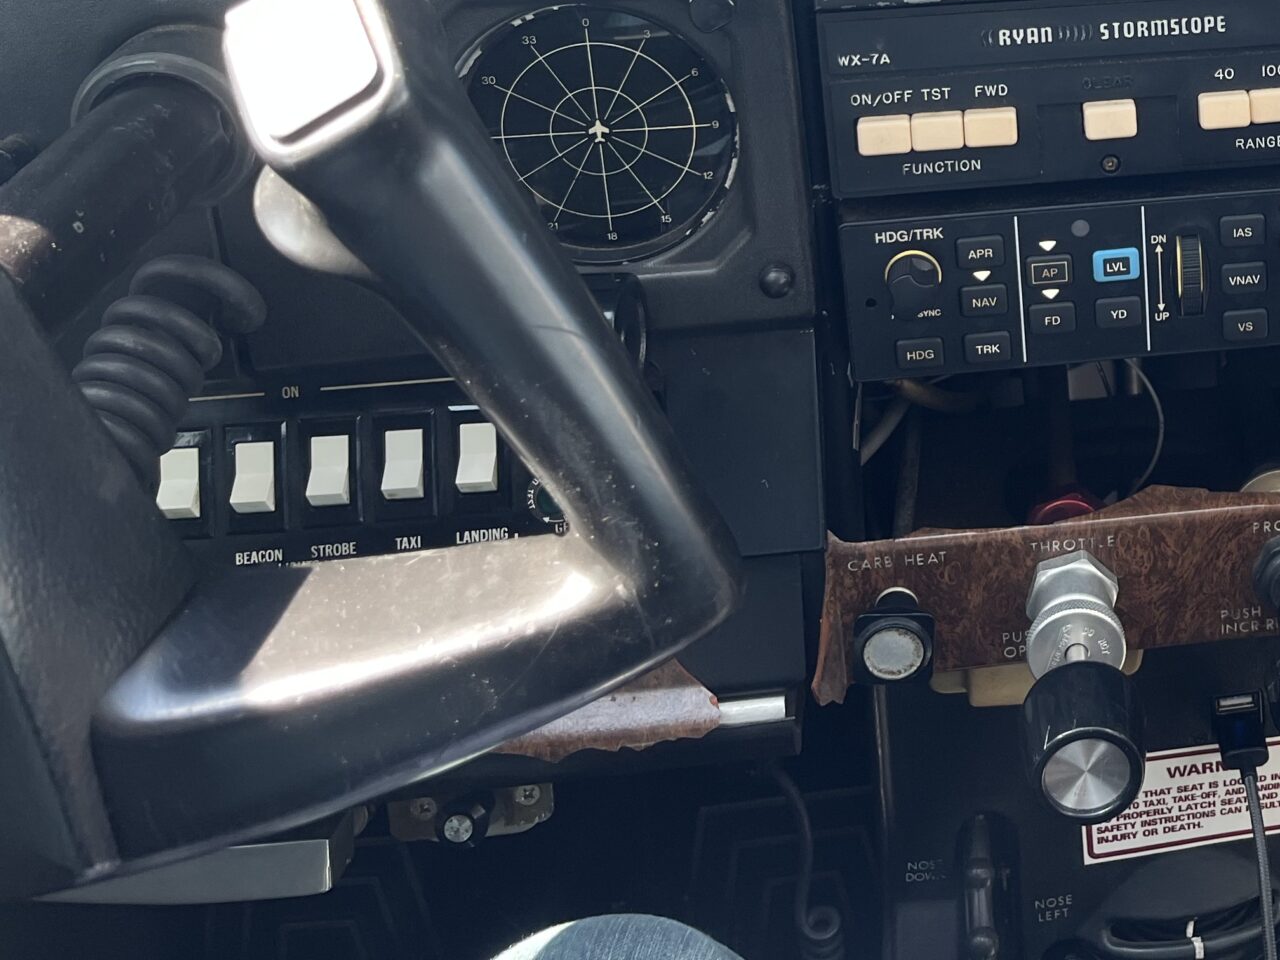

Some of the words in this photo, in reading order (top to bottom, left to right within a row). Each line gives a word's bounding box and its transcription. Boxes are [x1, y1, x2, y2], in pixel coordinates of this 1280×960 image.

[999, 27, 1053, 45] RYAN
[1100, 16, 1227, 40] STORMSCOPE
[838, 53, 891, 67] WX-7A
[1215, 67, 1234, 80] 40
[851, 89, 912, 106] ON/OFF
[921, 88, 950, 101] TST
[974, 84, 1008, 98] FWD
[903, 160, 982, 175] FUNCTION
[875, 228, 944, 243] HDG/TRK
[1151, 234, 1166, 244] DN
[1233, 227, 1252, 238] IAS
[968, 247, 993, 260] APR
[1042, 267, 1057, 279] AP
[1106, 261, 1126, 273] LVL
[1229, 273, 1260, 286] VNAV
[972, 296, 996, 308] NAV
[1045, 315, 1061, 326] FD
[1111, 308, 1126, 320] YD
[1155, 312, 1169, 321] UP
[1238, 321, 1253, 332] VS
[907, 349, 935, 361] HDG
[976, 343, 1000, 355] TRK
[281, 386, 299, 398] ON
[456, 527, 509, 544] LANDING
[395, 536, 421, 550] TAXI
[311, 542, 356, 558] STROBE
[235, 548, 283, 566] BEACON
[848, 556, 894, 571] CARB
[905, 552, 947, 566] HEAT
[1221, 621, 1259, 634] INCR
[1144, 788, 1172, 798] THAT
[1176, 784, 1204, 793] SEAT
[1097, 822, 1136, 834] SAFETY
[1140, 810, 1216, 827] INSTRUCTIONS
[1220, 806, 1240, 814] CAN
[1097, 831, 1138, 844] INJURY
[1142, 828, 1158, 836] OR
[1162, 821, 1204, 834] DEATH.
